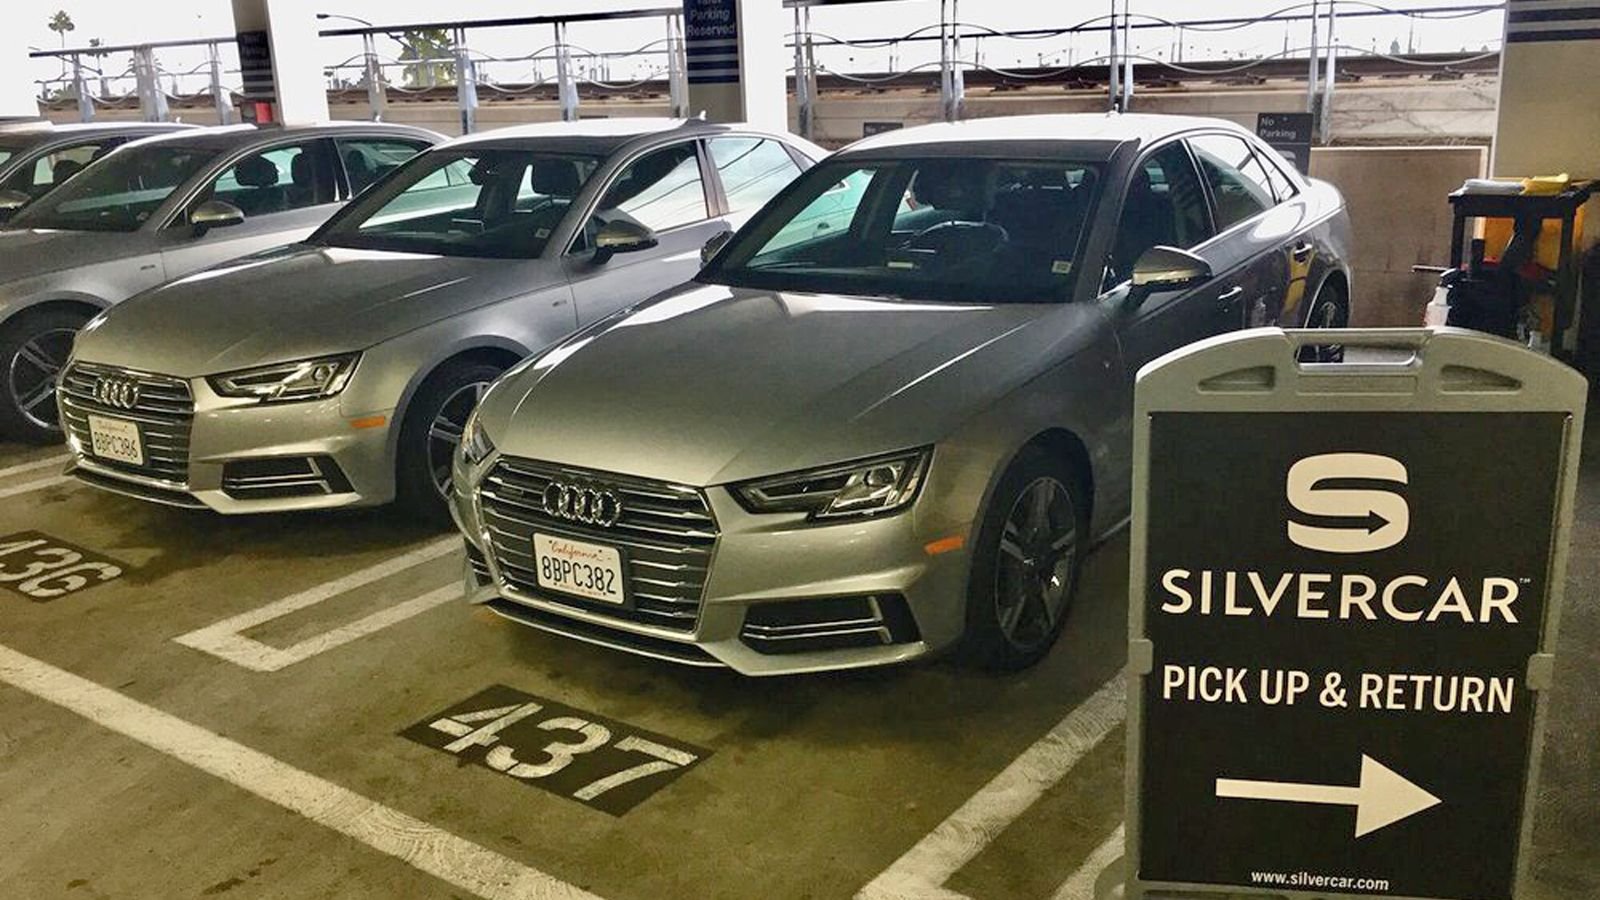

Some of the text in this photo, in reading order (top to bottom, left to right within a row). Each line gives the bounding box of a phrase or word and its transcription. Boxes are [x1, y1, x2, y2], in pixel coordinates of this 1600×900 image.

[690, 9, 730, 21] Parking
[687, 23, 736, 36] Reserved
[1260, 117, 1275, 126] No
[1260, 128, 1297, 140] Parking
[542, 555, 617, 595] 8BPC382
[1162, 569, 1519, 623] SILVERCAR
[1164, 665, 1513, 712] PICK UP & RETURN
[429, 702, 697, 800] 437
[1251, 872, 1389, 890] www.silvercar.com
